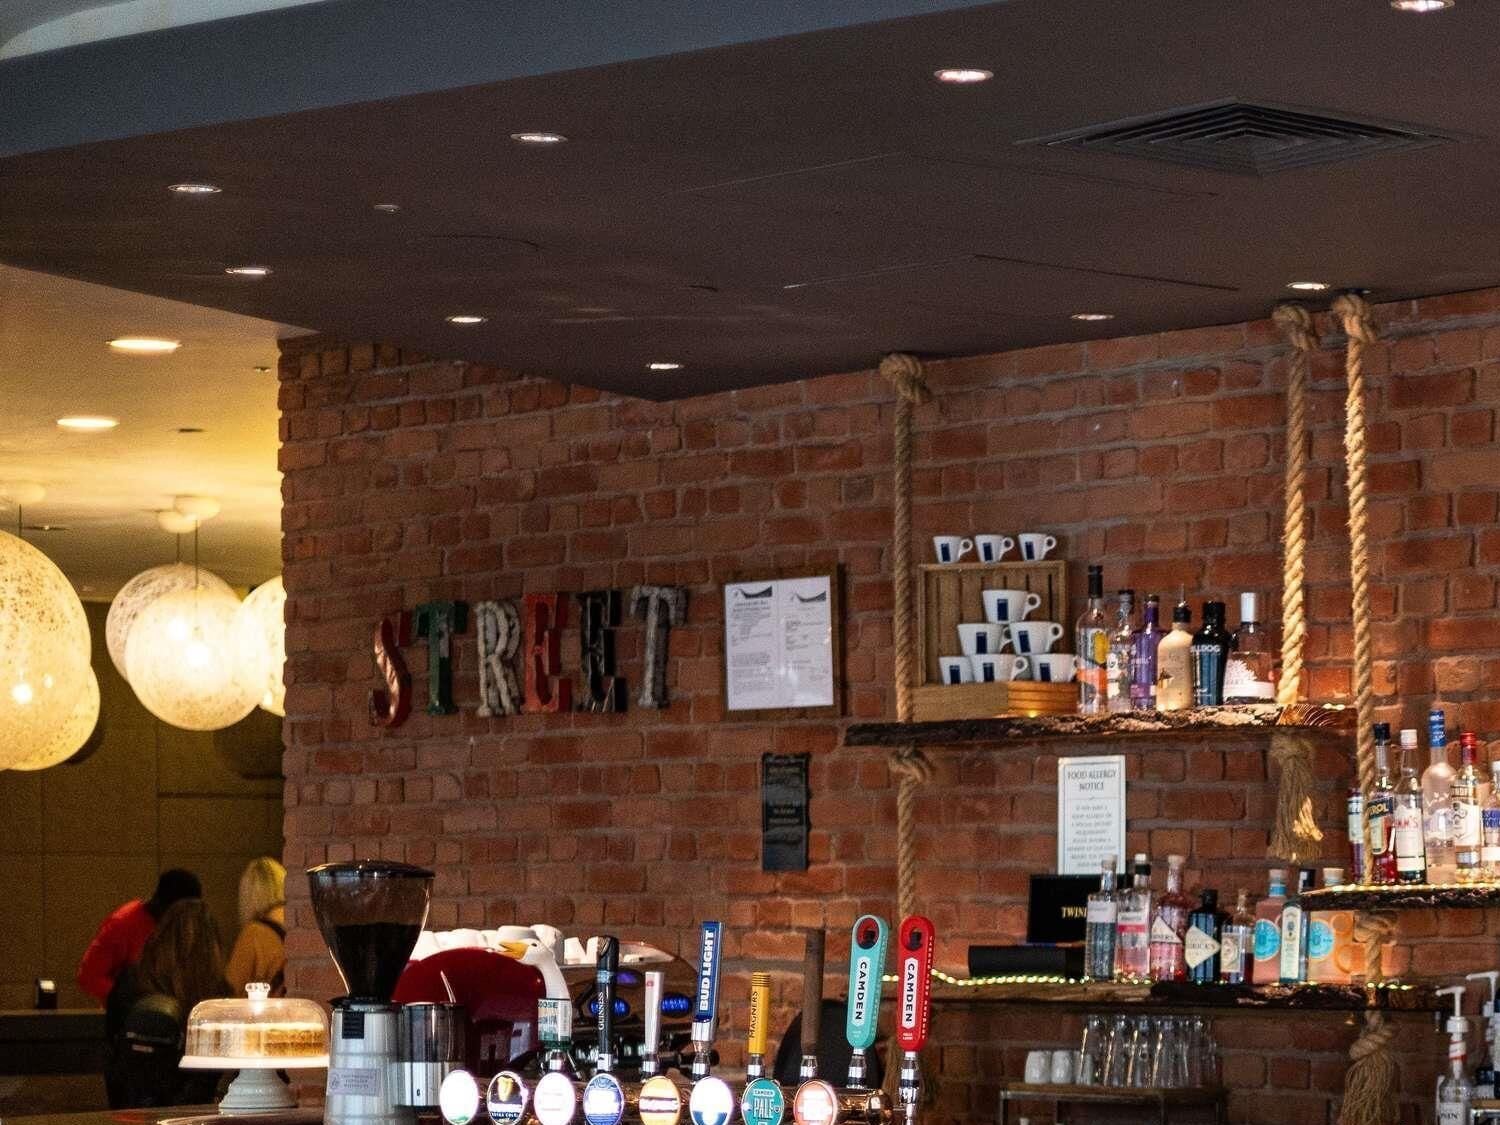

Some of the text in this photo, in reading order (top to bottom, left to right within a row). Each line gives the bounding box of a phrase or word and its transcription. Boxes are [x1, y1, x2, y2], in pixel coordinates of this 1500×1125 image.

[368, 586, 689, 727] STREET
[699, 930, 715, 1011] BUD LIGHT
[855, 961, 867, 1020] CAMDEN
[906, 963, 915, 1022] CAMDEN
[749, 991, 758, 1039] MAGNERS
[753, 1097, 775, 1118] PALE
